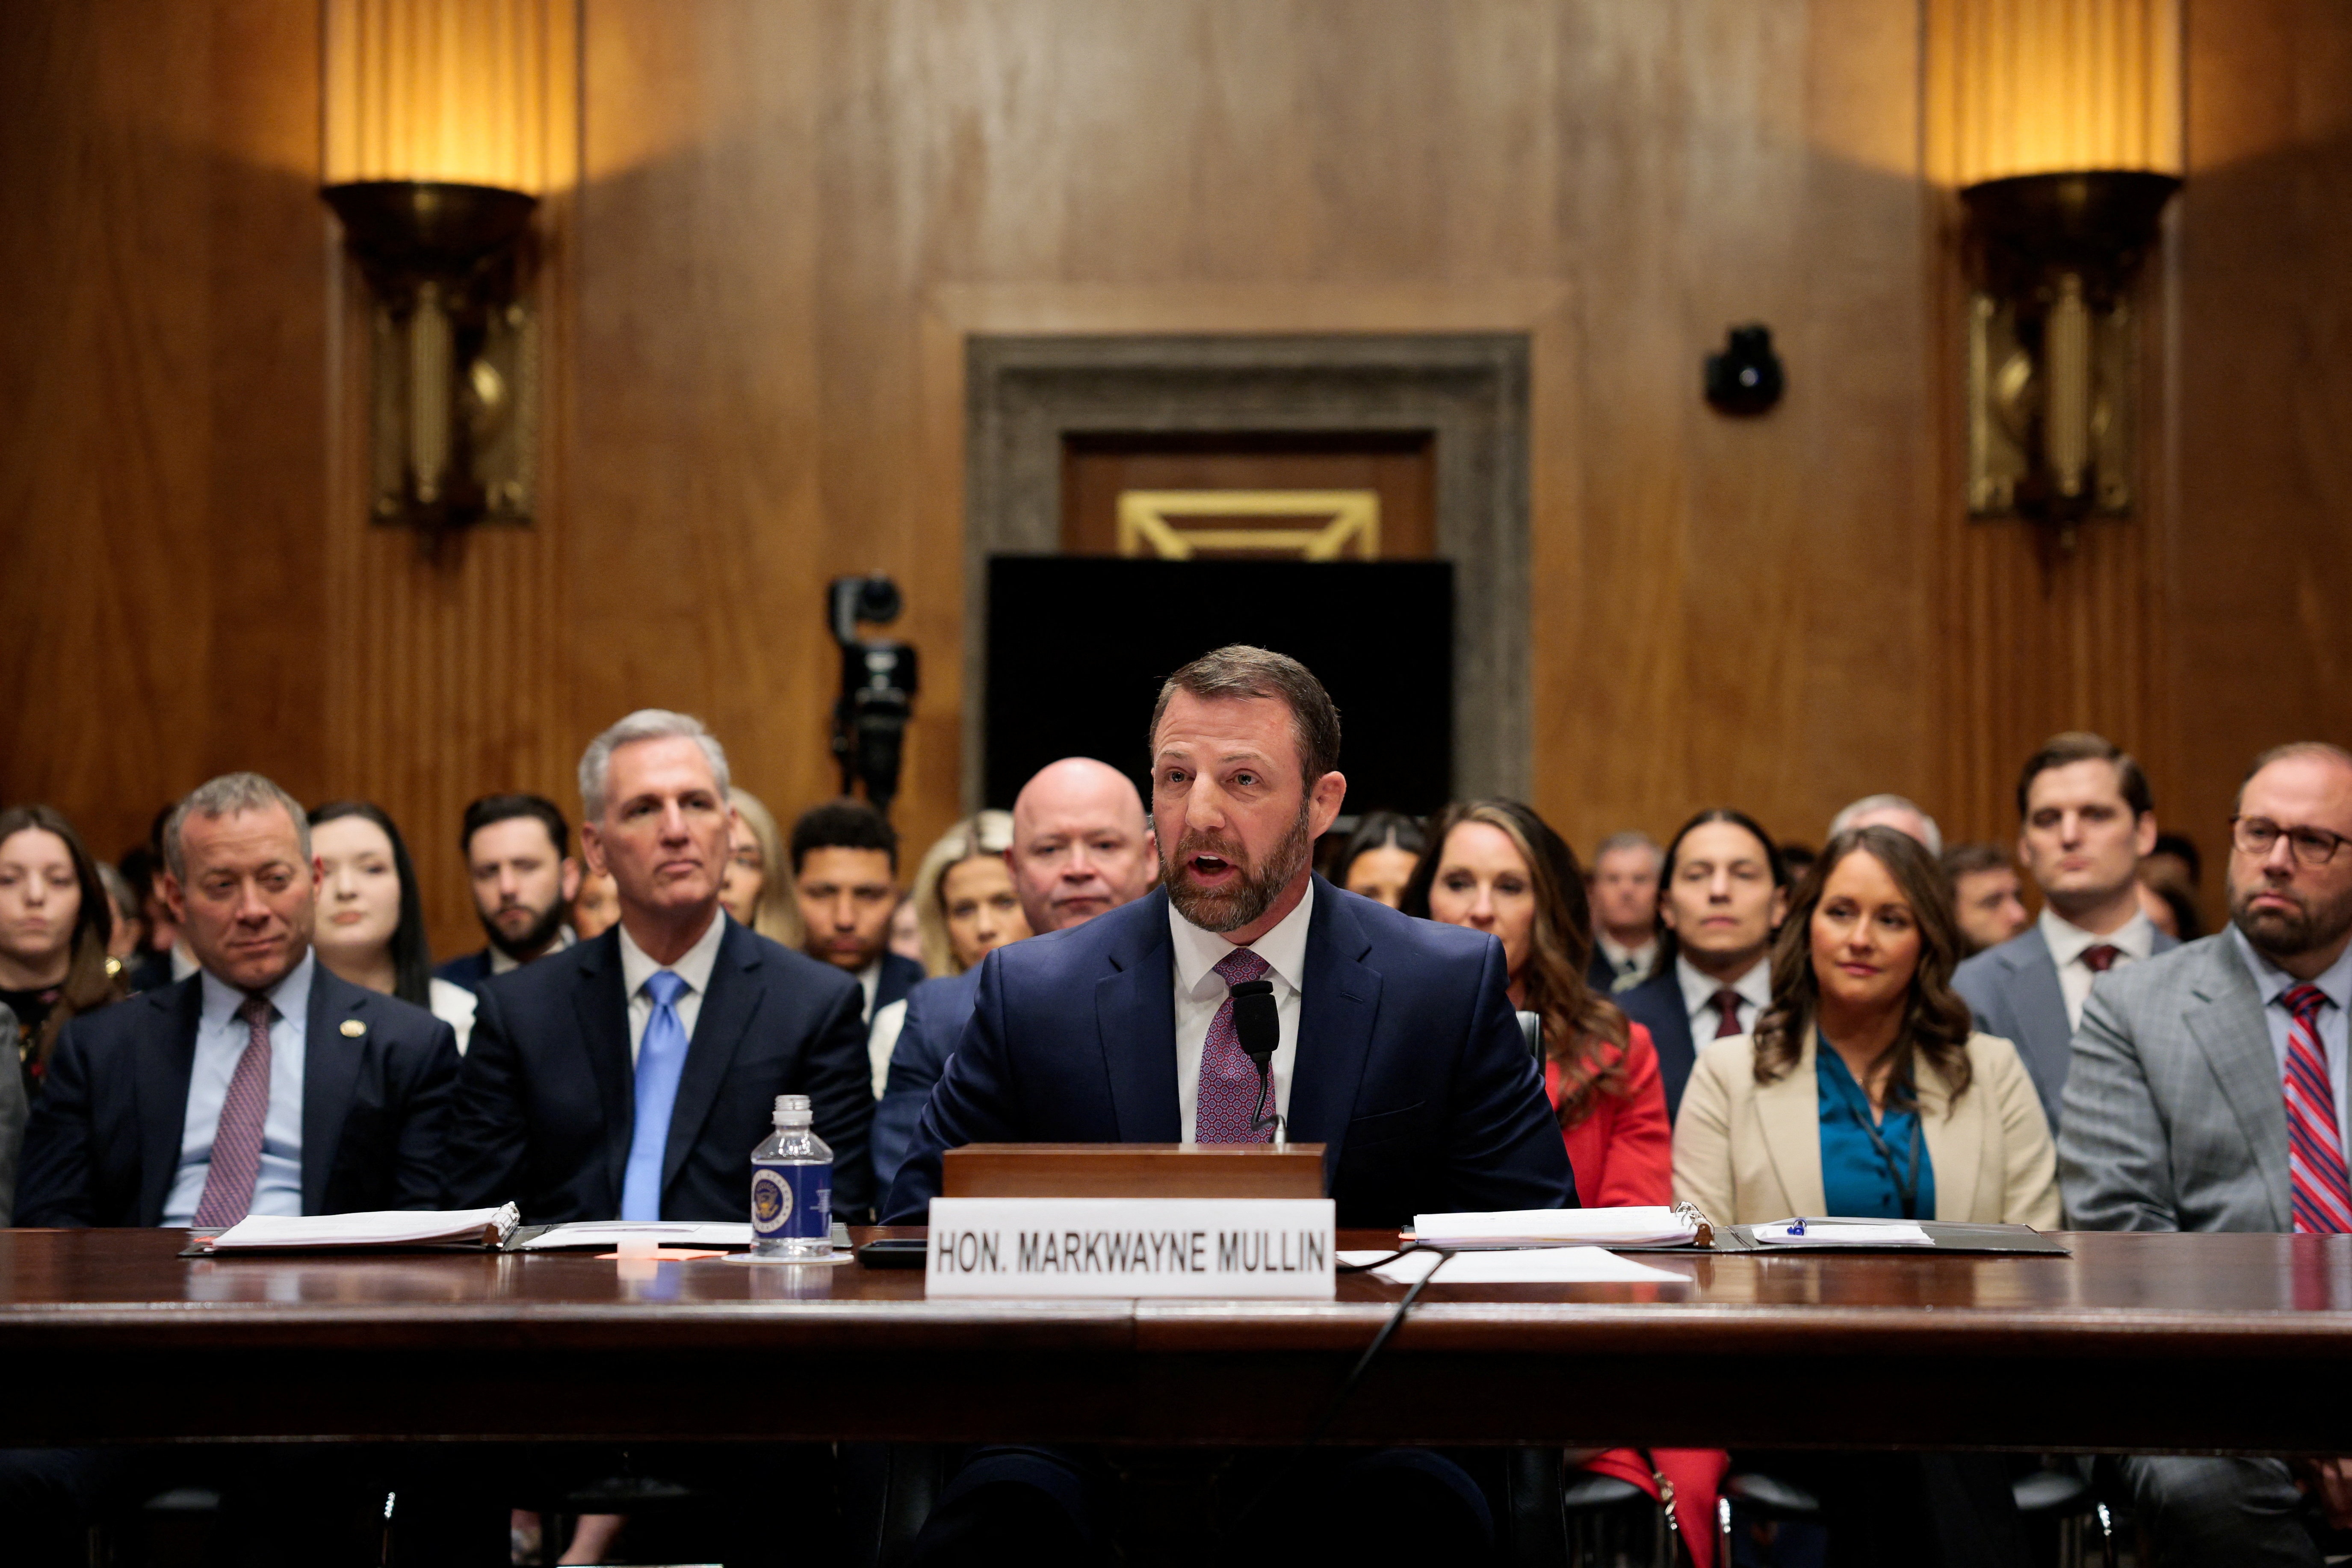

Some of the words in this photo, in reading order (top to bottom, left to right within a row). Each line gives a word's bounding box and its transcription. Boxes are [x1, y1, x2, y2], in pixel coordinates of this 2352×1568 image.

[937, 1231, 1006, 1273] HON.
[1018, 1231, 1206, 1273] MARKWAYNE
[1218, 1231, 1324, 1273] MULLIN
